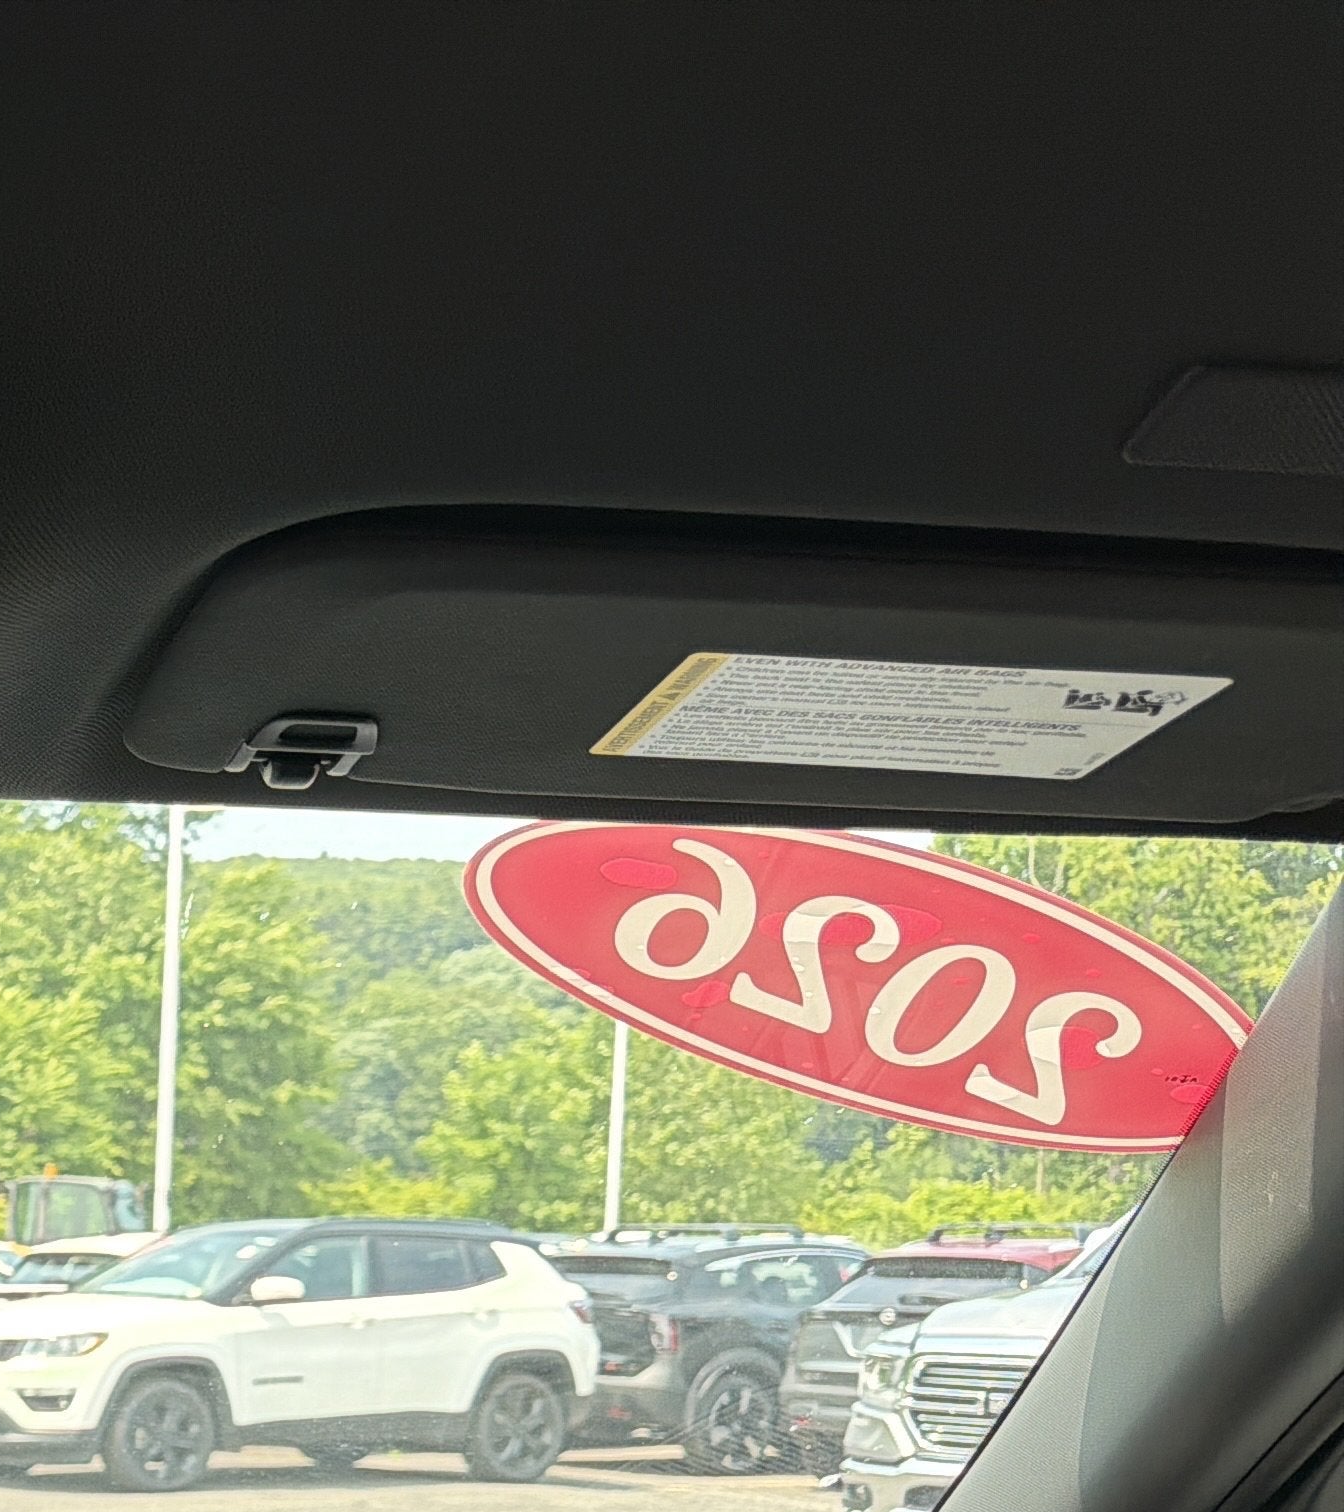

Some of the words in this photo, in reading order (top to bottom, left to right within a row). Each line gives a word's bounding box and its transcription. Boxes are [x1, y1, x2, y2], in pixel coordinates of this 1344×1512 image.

[733, 657, 781, 666] EVEN
[785, 659, 833, 668] WITH
[833, 661, 934, 674] ADVANCED
[859, 714, 964, 726] GONFLABLES
[967, 718, 1082, 731] INTELLIGENTS
